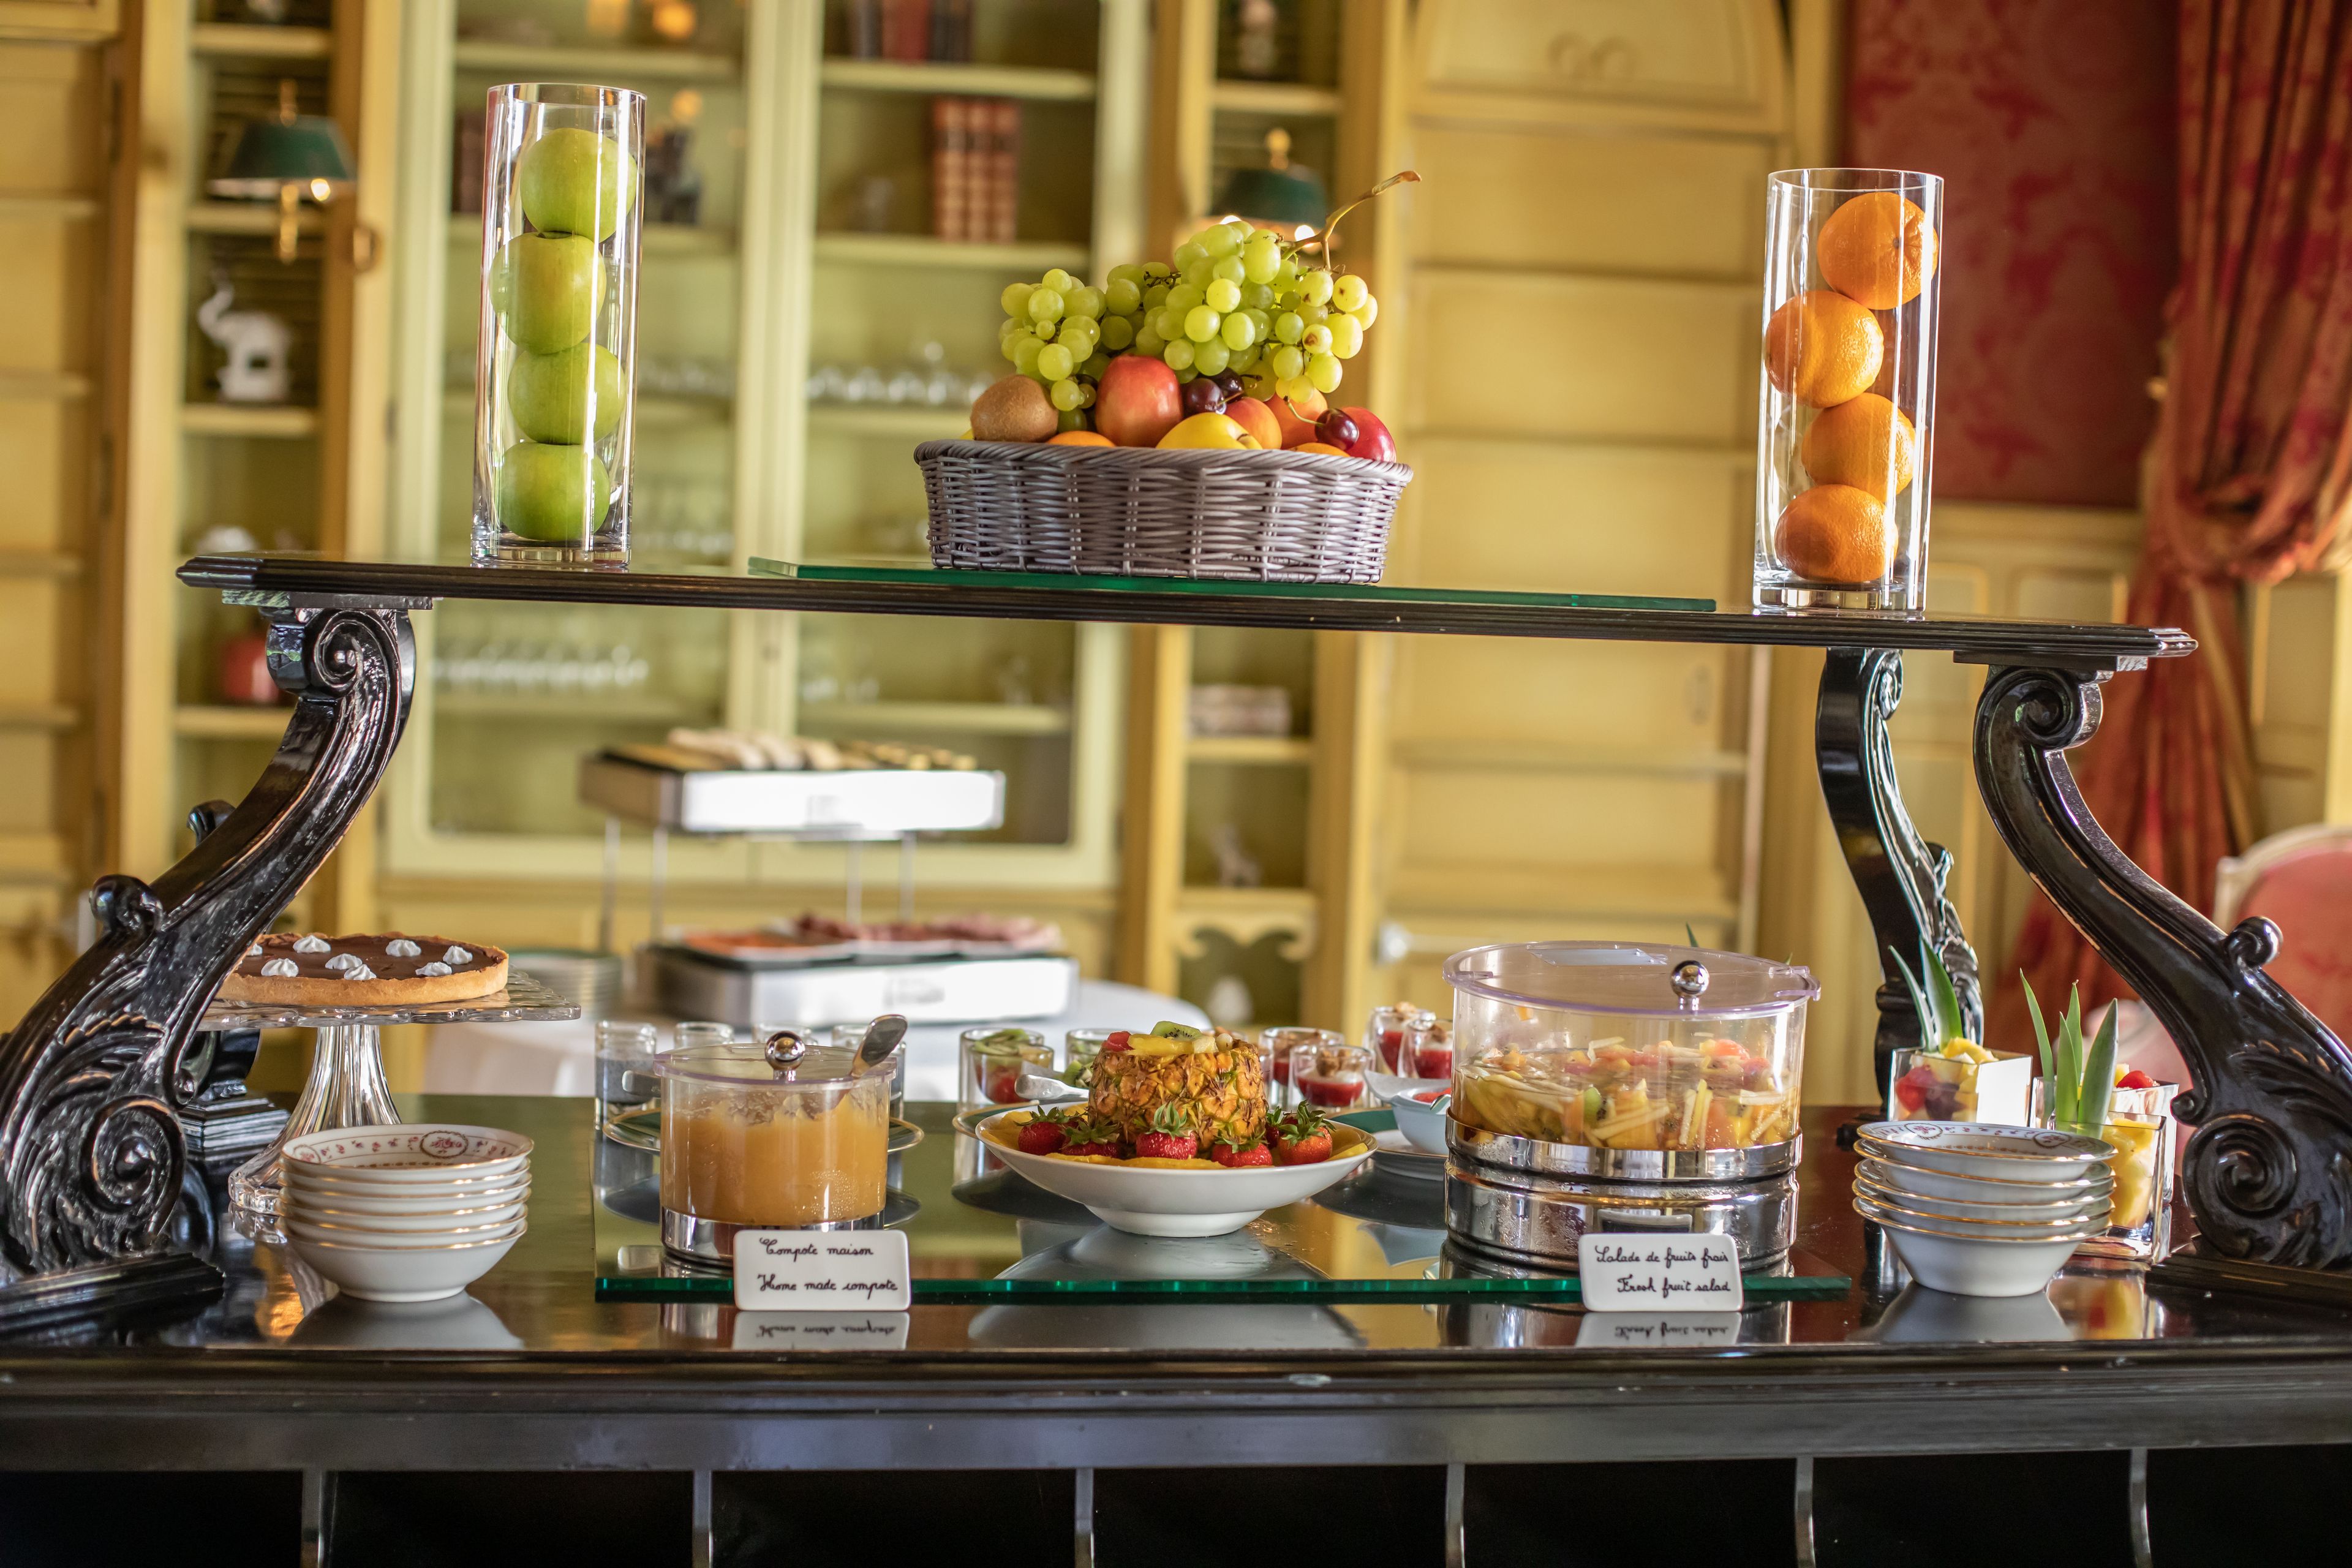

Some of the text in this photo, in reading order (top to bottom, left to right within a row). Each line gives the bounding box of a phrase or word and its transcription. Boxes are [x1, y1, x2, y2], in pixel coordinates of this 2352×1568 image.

[759, 1237, 874, 1263] Compote maison
[1594, 1245, 1729, 1270] Salade de fruits frais
[756, 1273, 899, 1300] Home made compote
[1616, 1273, 1732, 1299] Fresh fruit salad
